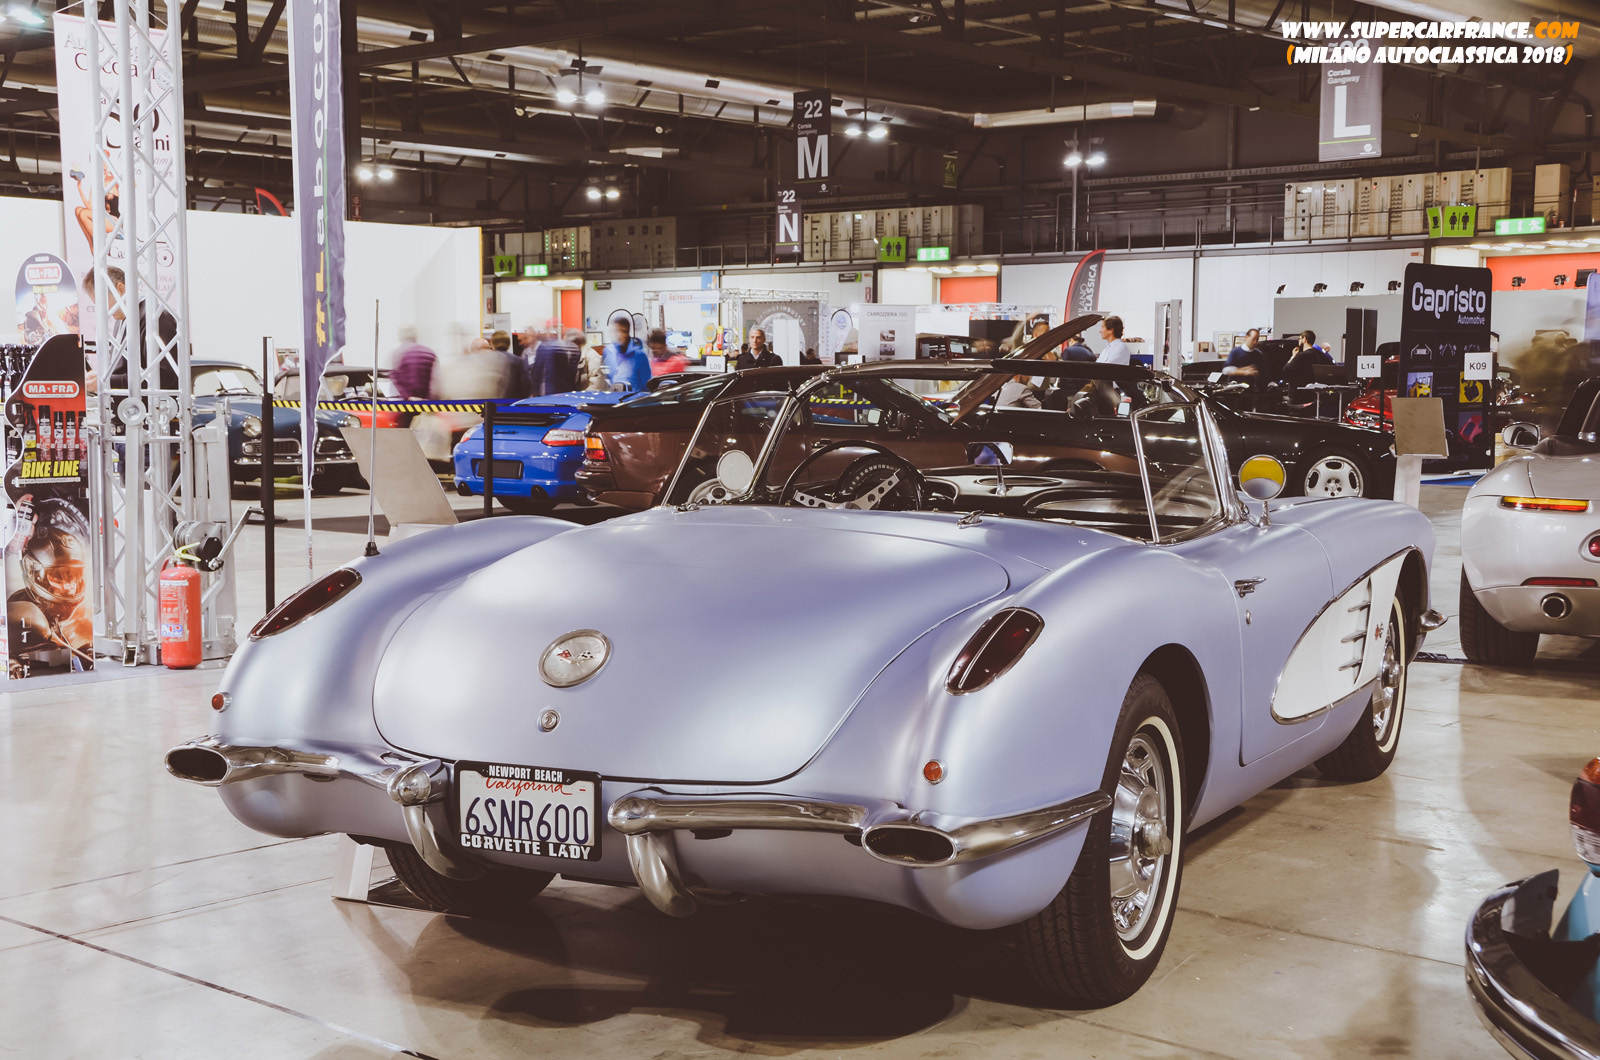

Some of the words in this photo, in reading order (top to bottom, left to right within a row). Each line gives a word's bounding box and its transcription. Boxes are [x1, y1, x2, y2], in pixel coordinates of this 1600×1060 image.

[1327, 69, 1351, 77] Corsia
[1327, 76, 1360, 84] Gangway
[804, 99, 823, 119] 22
[1333, 85, 1371, 138] L
[797, 134, 829, 179] M
[782, 190, 796, 203] 22
[779, 213, 798, 243] N
[1411, 282, 1486, 319] Capristo
[1457, 314, 1485, 325] Automotive
[1469, 362, 1487, 371] K09
[22, 460, 51, 478] BIKE
[53, 460, 79, 477] LINE
[488, 765, 531, 780] NEWPORT
[534, 769, 563, 782] BEACH
[486, 777, 573, 797] California
[465, 797, 589, 845] 6SNR600
[461, 833, 541, 855] CORVETTE
[549, 843, 591, 860] LADY
